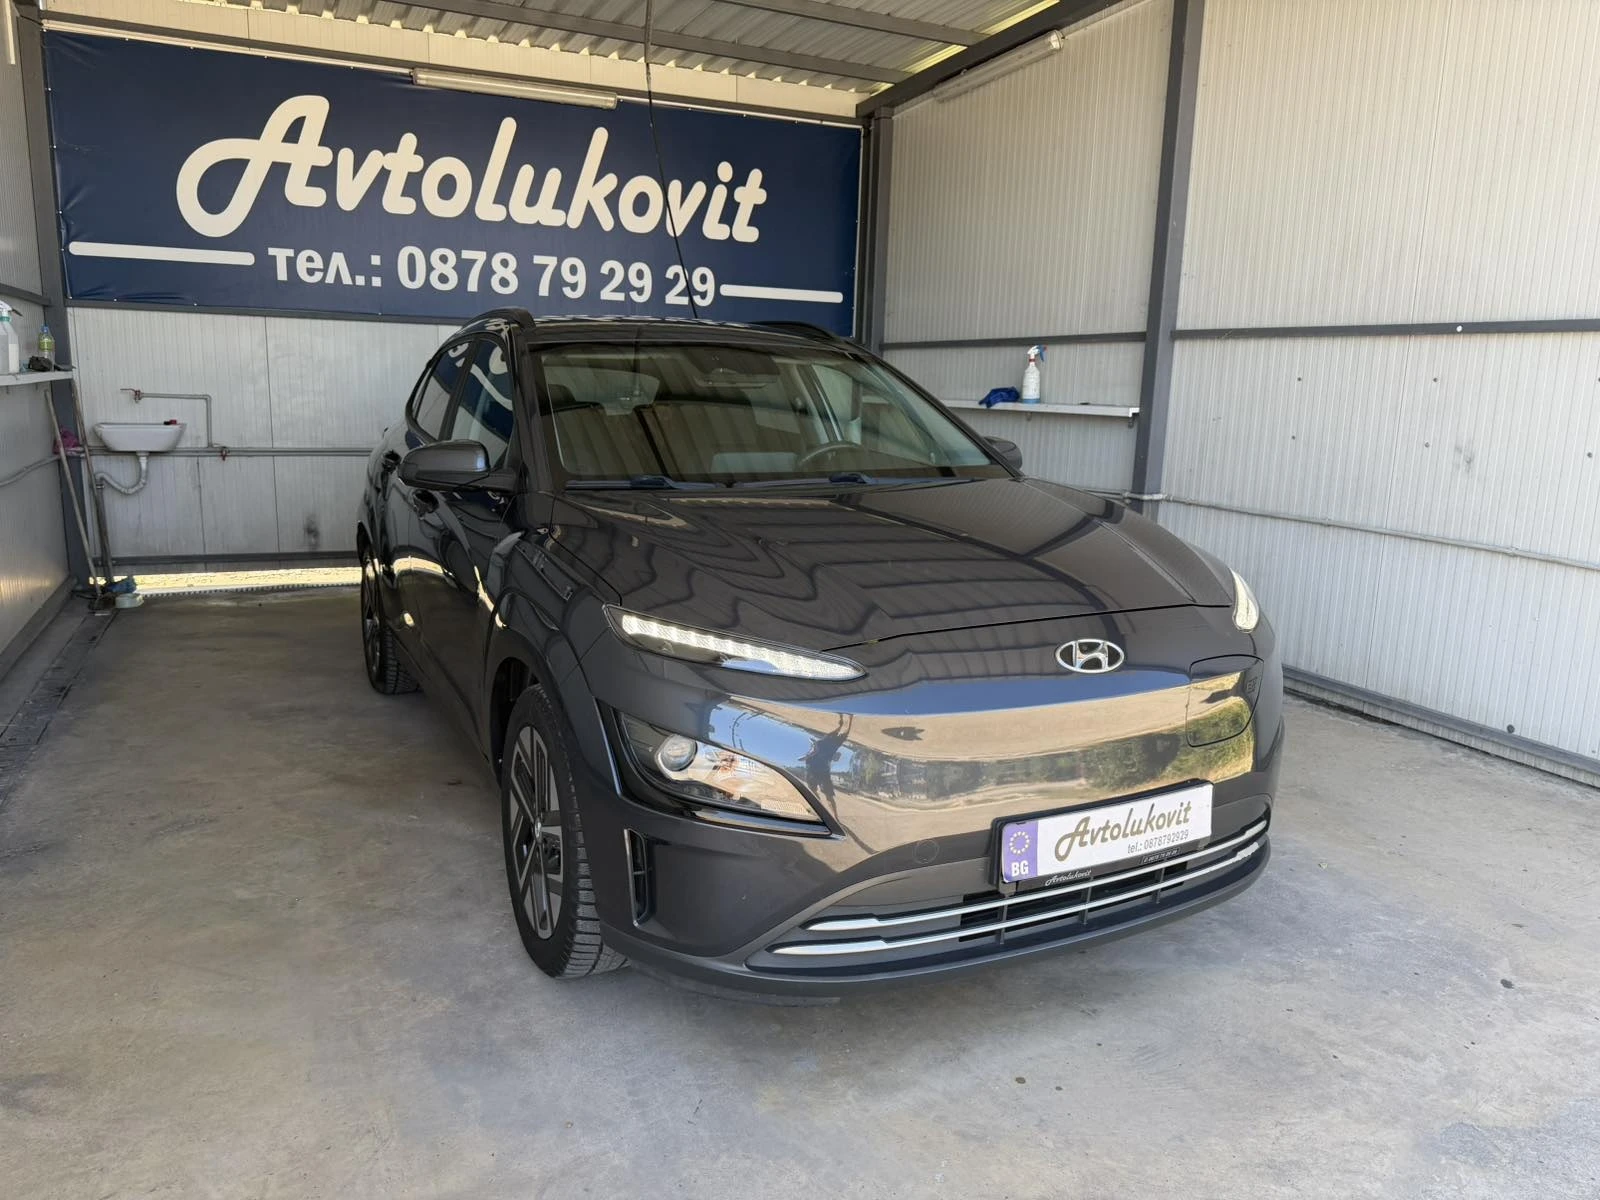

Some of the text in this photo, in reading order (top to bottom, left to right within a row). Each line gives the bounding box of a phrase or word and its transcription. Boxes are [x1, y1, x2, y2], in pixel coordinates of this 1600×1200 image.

[176, 94, 767, 243] Avtolukovit
[267, 244, 716, 307] тел.: 0878 79 29 29
[1054, 800, 1192, 862] Avtolukovit
[1127, 830, 1189, 854] tel.: 0878792929
[1011, 860, 1029, 877] BG
